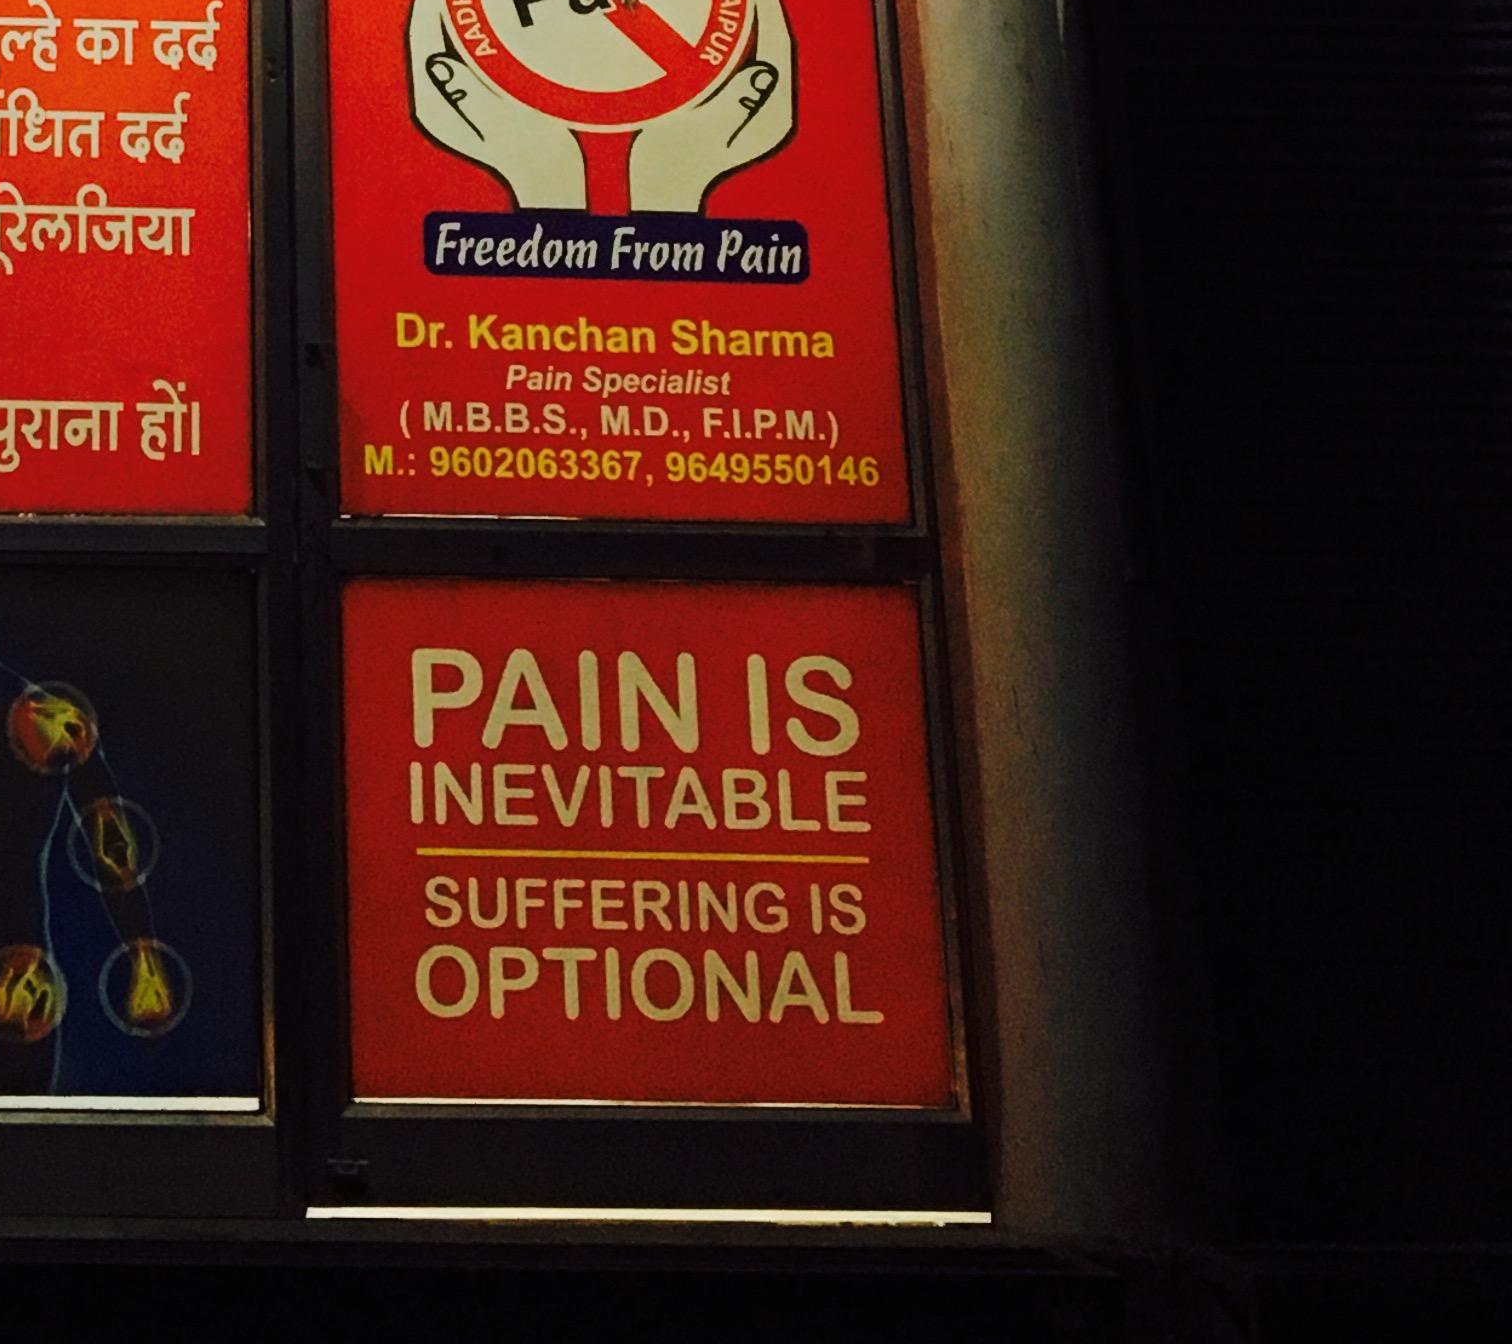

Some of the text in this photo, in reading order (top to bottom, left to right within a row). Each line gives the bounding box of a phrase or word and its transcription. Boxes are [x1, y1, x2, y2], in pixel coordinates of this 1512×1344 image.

[150, 1, 224, 70] दर्द
[716, 229, 803, 275] Pain
[505, 364, 732, 399] Pain Specialist
[429, 446, 655, 487] 9602063367,
[411, 647, 861, 757] PAIN IS
[409, 761, 872, 833] INEVITABLE
[423, 875, 868, 936] SUFFERING IS
[415, 944, 885, 1025] OPTIONAL
